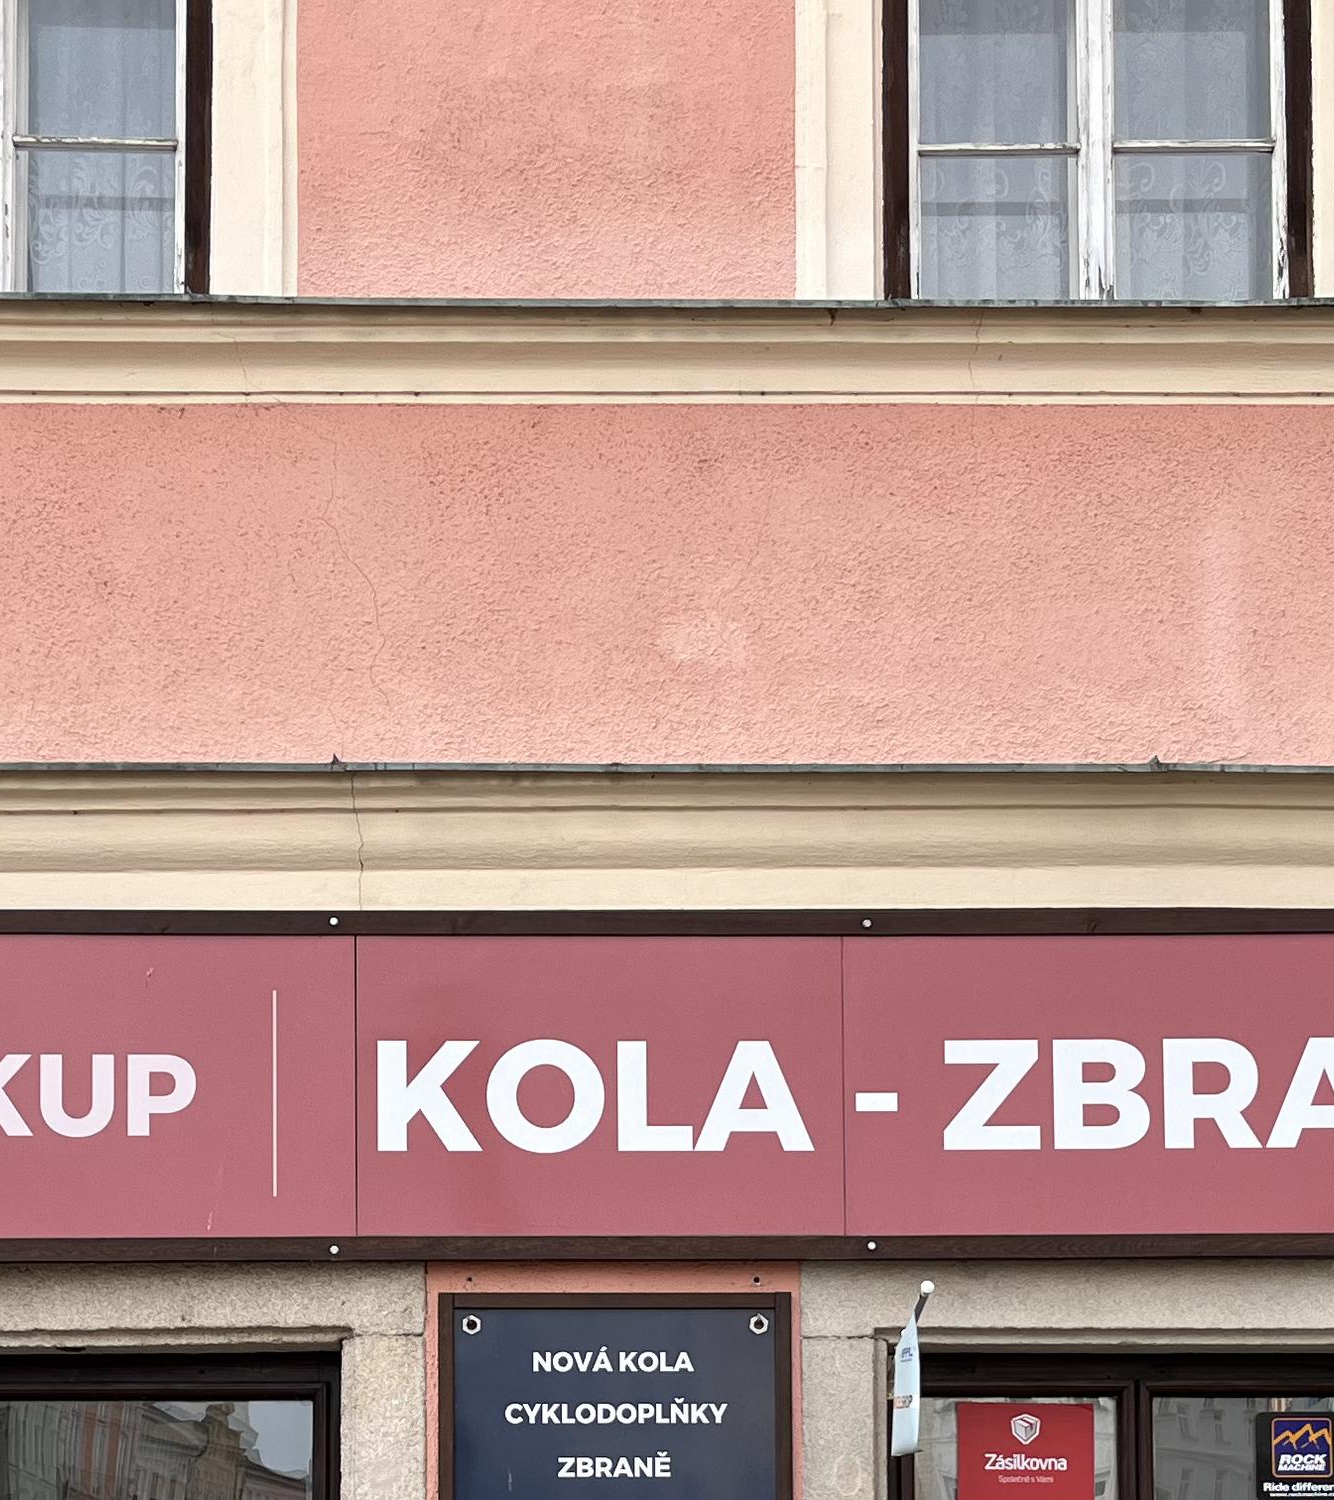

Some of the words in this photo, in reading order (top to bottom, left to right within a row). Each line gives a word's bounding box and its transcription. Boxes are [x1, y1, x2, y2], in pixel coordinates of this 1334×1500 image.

[375, 1039, 815, 1154] KOLA
[855, 1092, 899, 1112] -
[532, 1345, 613, 1373] NOVÁ
[619, 1351, 695, 1373] KOLA
[504, 1397, 728, 1425] CYKLODOPLŇKY
[557, 1451, 671, 1478] ZBRANĚ
[984, 1453, 1068, 1471] Zásilkovna
[1278, 1463, 1326, 1471] MACHINE
[1279, 1454, 1327, 1465] ROCK
[1263, 1482, 1290, 1492] Ride
